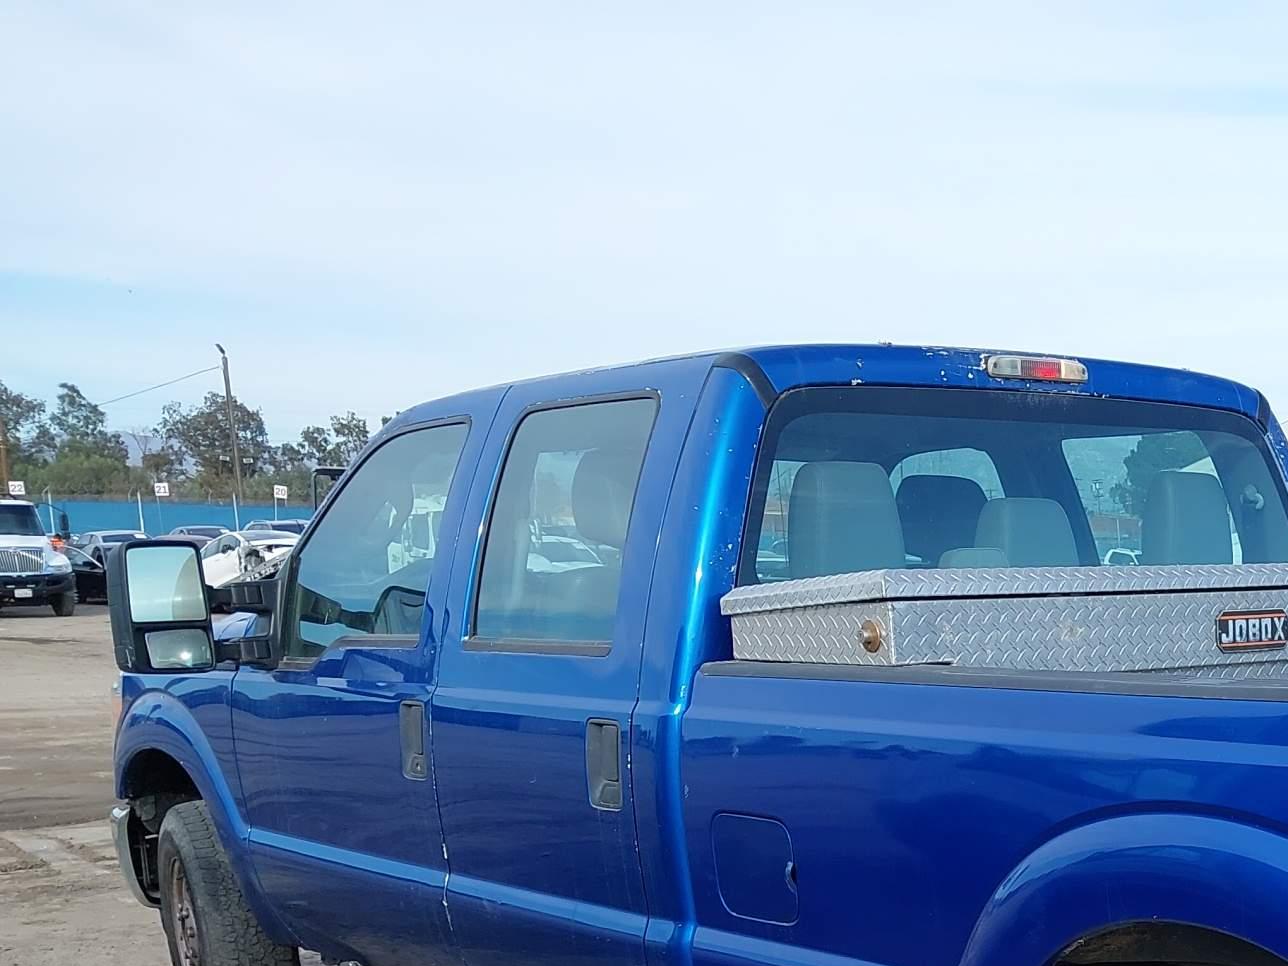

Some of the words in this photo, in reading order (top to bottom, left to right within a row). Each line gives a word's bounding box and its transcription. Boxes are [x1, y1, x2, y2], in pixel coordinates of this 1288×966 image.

[10, 483, 23, 493] 22
[155, 485, 169, 494] 21
[275, 487, 286, 497] 20
[1220, 616, 1286, 644] JOBOX
